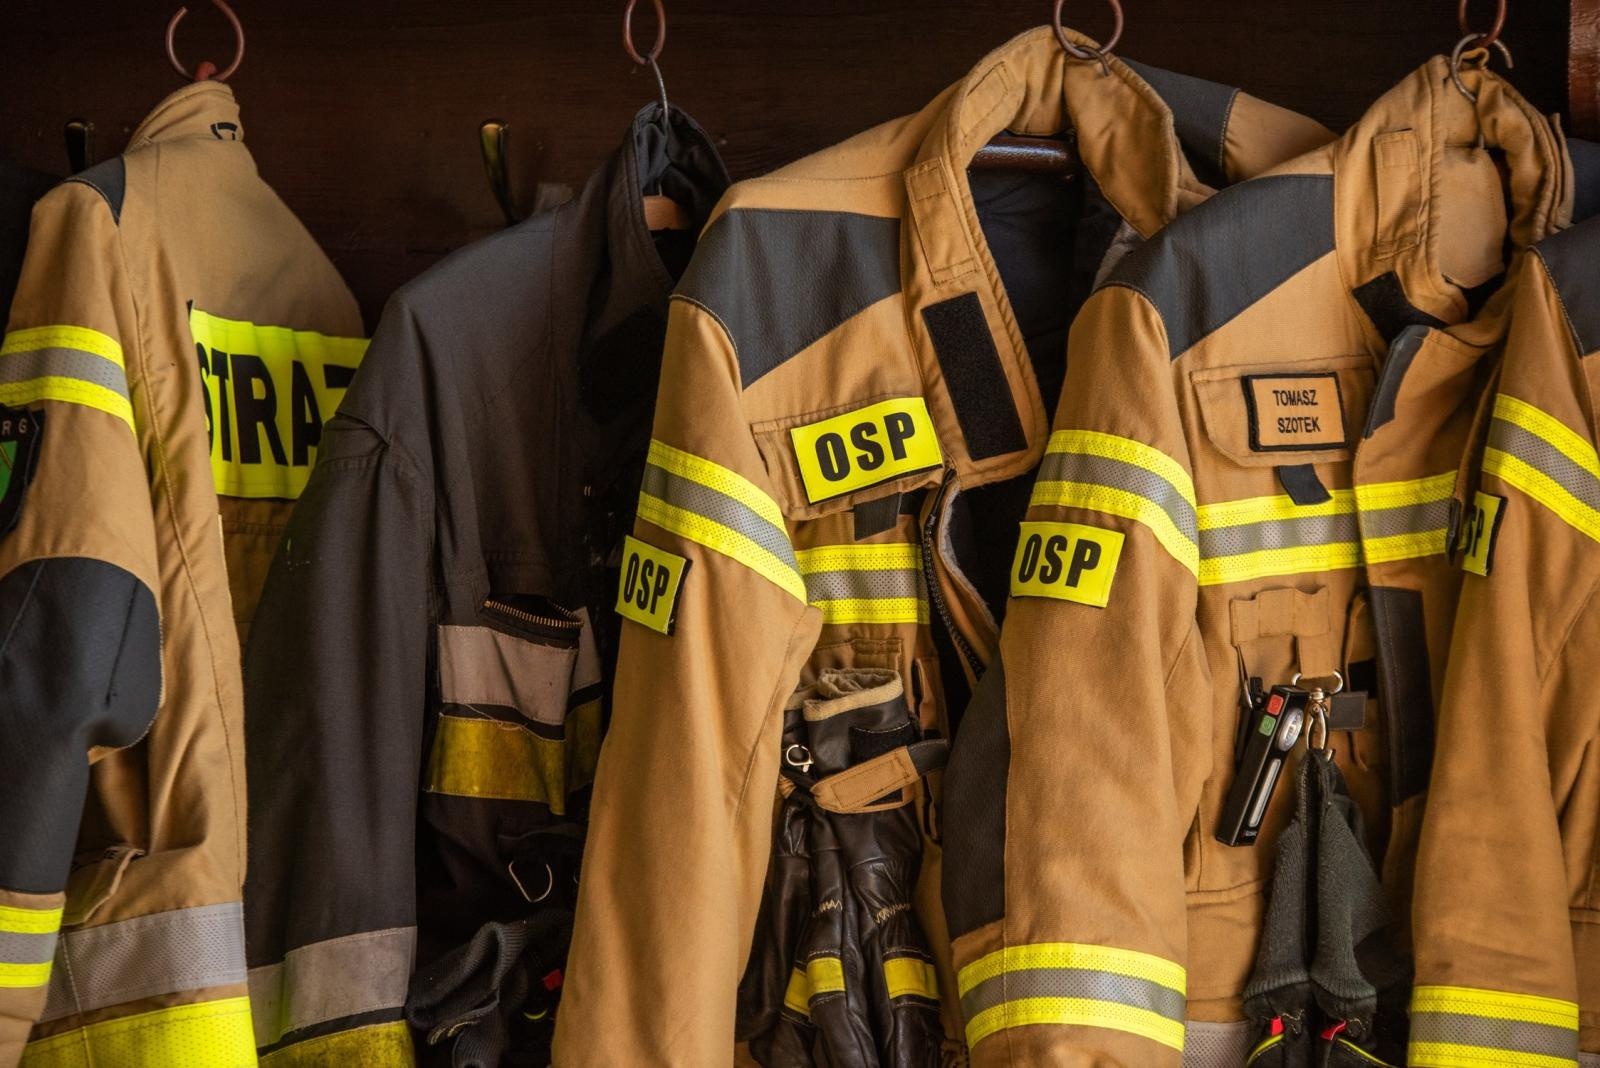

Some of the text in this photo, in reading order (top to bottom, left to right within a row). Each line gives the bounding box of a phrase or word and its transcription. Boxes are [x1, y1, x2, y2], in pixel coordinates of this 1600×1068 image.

[196, 342, 357, 466] STRA
[1272, 389, 1318, 406] TOMASZ
[1277, 416, 1321, 433] SZOTEK
[814, 411, 915, 482] OSP
[623, 552, 670, 614] OSP
[1018, 533, 1102, 588] OSP
